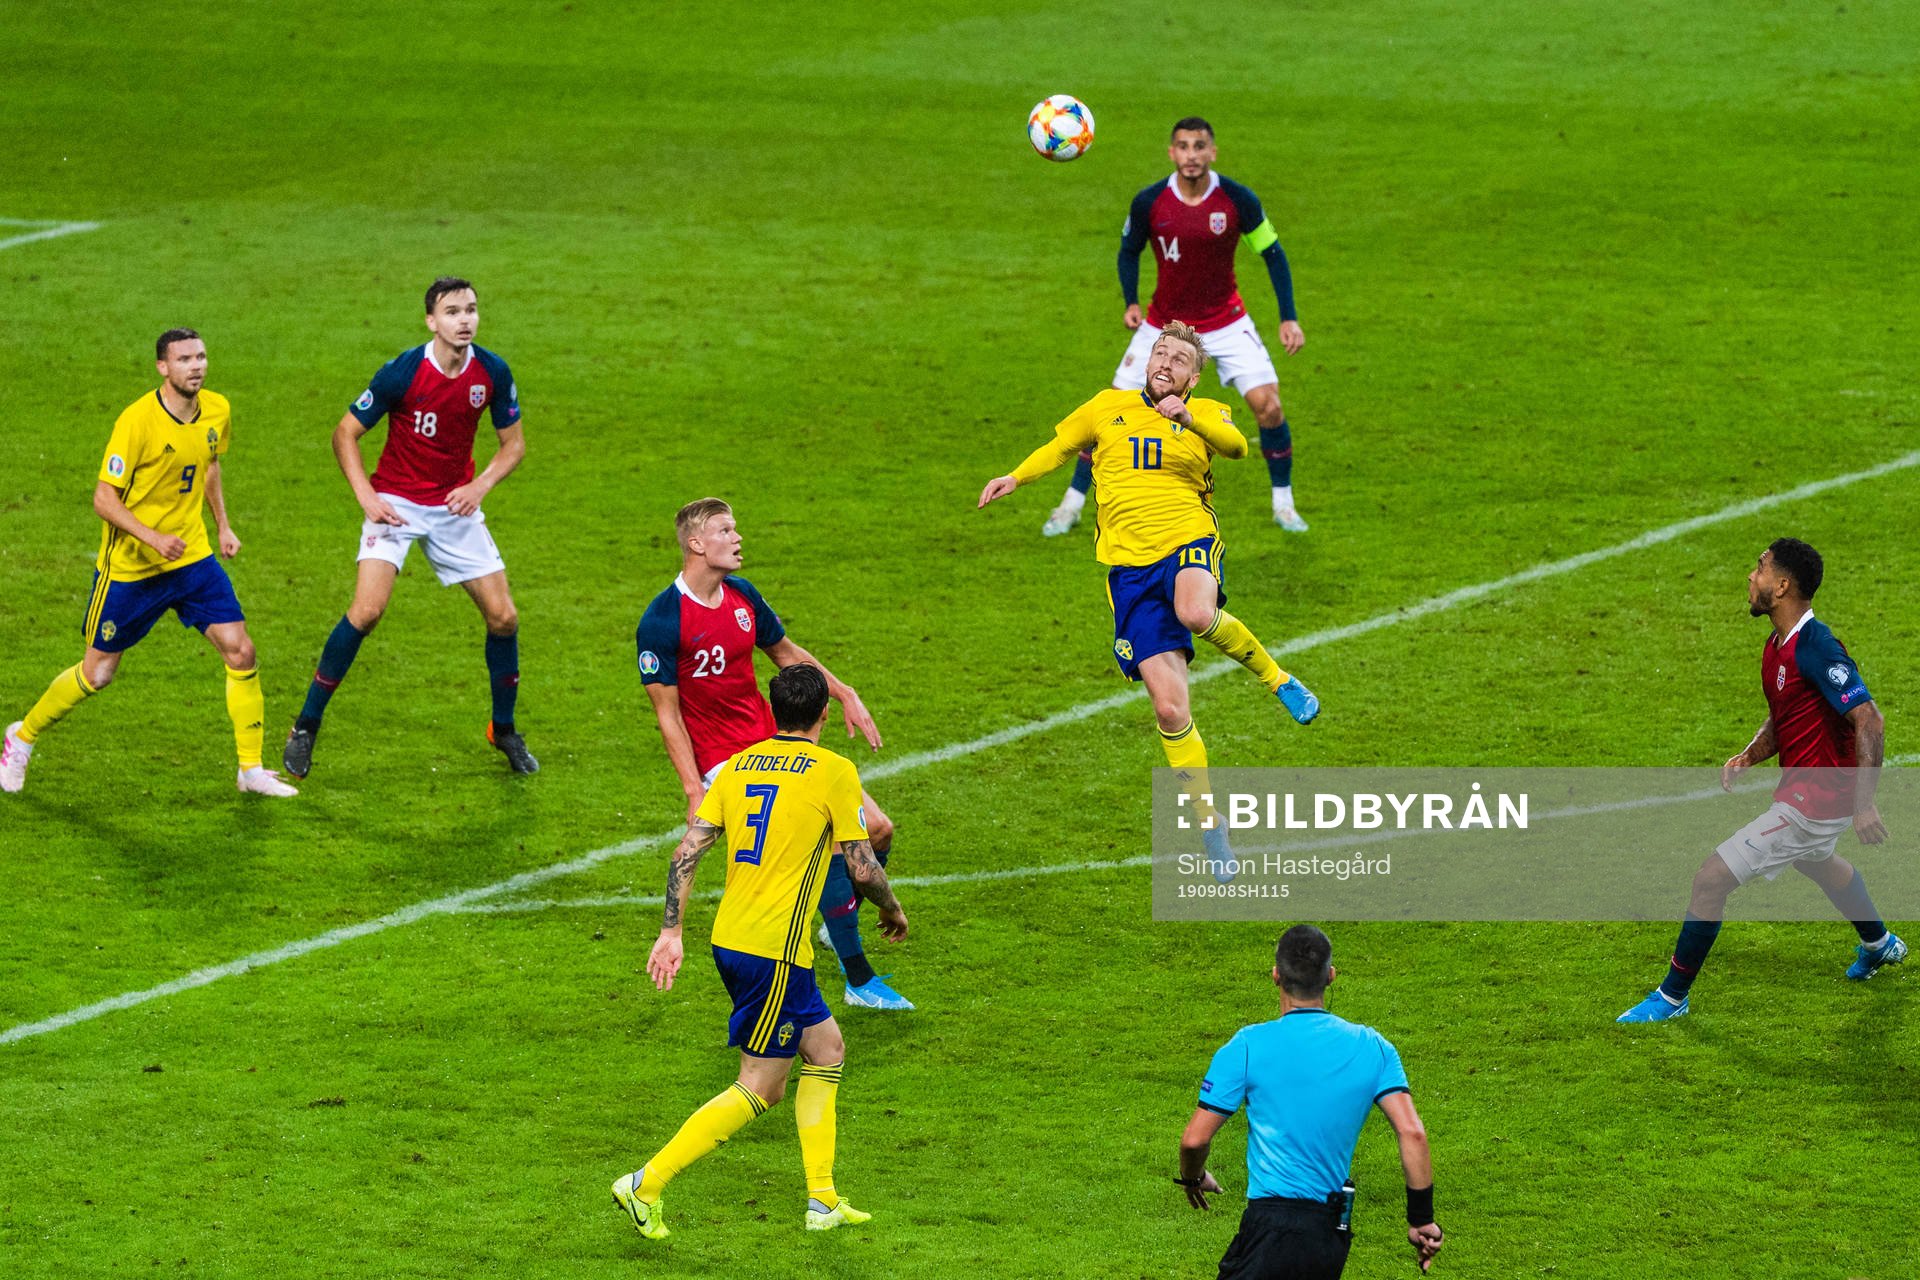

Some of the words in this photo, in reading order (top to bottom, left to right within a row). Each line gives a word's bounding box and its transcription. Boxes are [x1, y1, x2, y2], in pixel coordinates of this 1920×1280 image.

[1157, 236, 1181, 263] 14
[414, 410, 438, 438] 18
[1128, 437, 1162, 470] 10
[179, 464, 197, 494] 9
[1177, 547, 1207, 567] 10
[692, 645, 726, 678] 23
[734, 752, 817, 775] LINDELÖF
[734, 783, 780, 867] 3
[1760, 815, 1791, 837] 7
